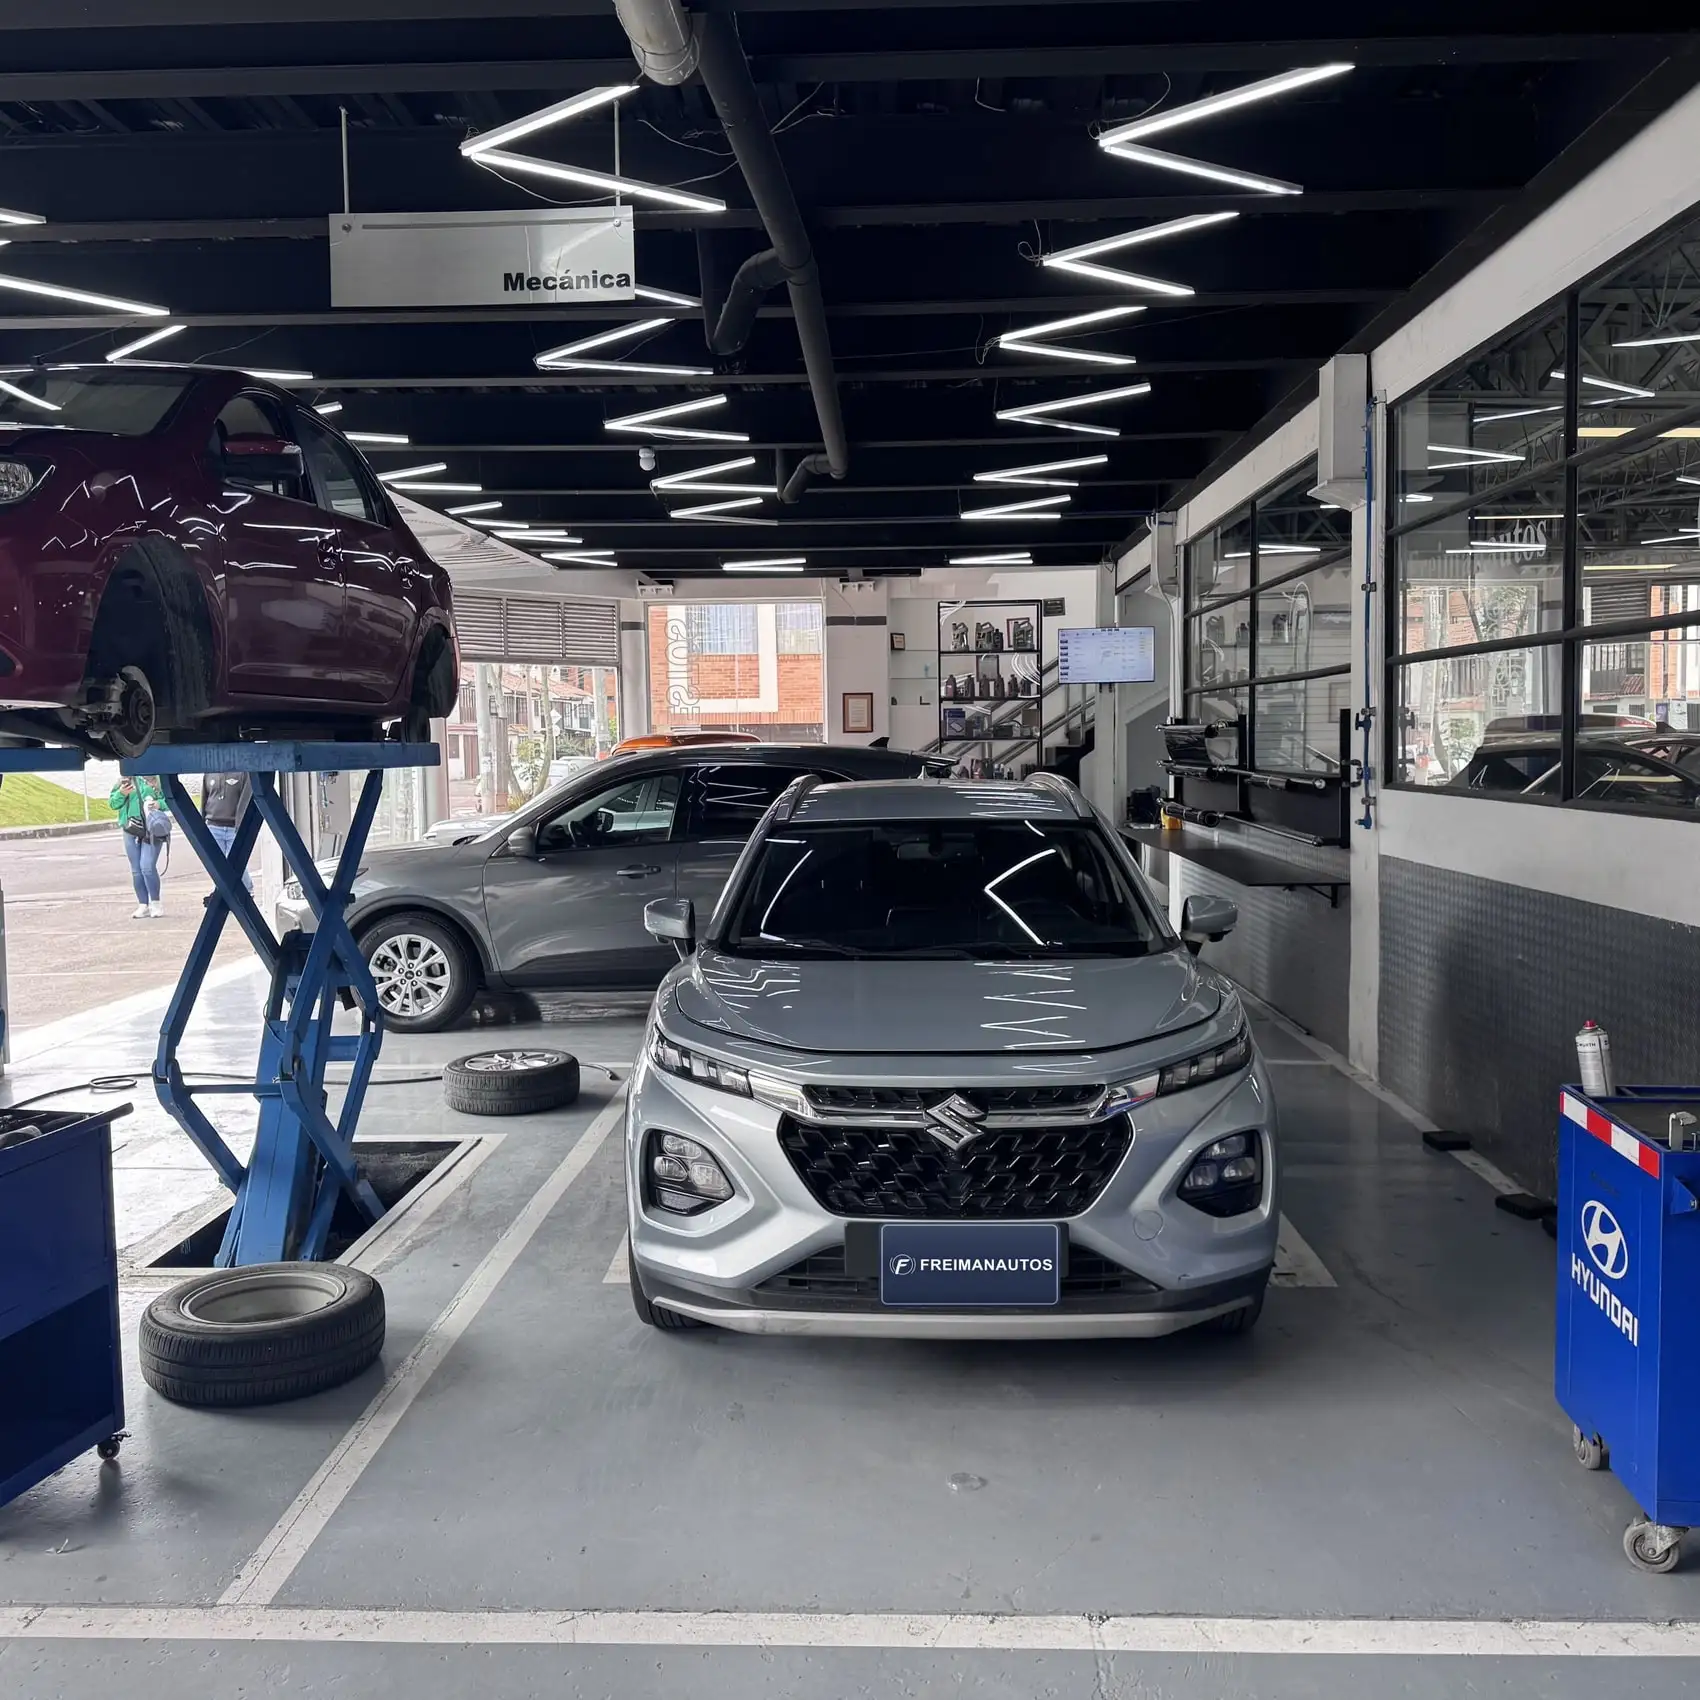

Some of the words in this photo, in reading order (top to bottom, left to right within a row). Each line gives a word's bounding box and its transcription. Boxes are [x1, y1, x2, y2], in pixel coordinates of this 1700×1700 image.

[503, 269, 631, 292] Mecánica
[920, 1258, 1053, 1271] FREIMANAUTOS
[1571, 1252, 1639, 1347] HYUNDAI
